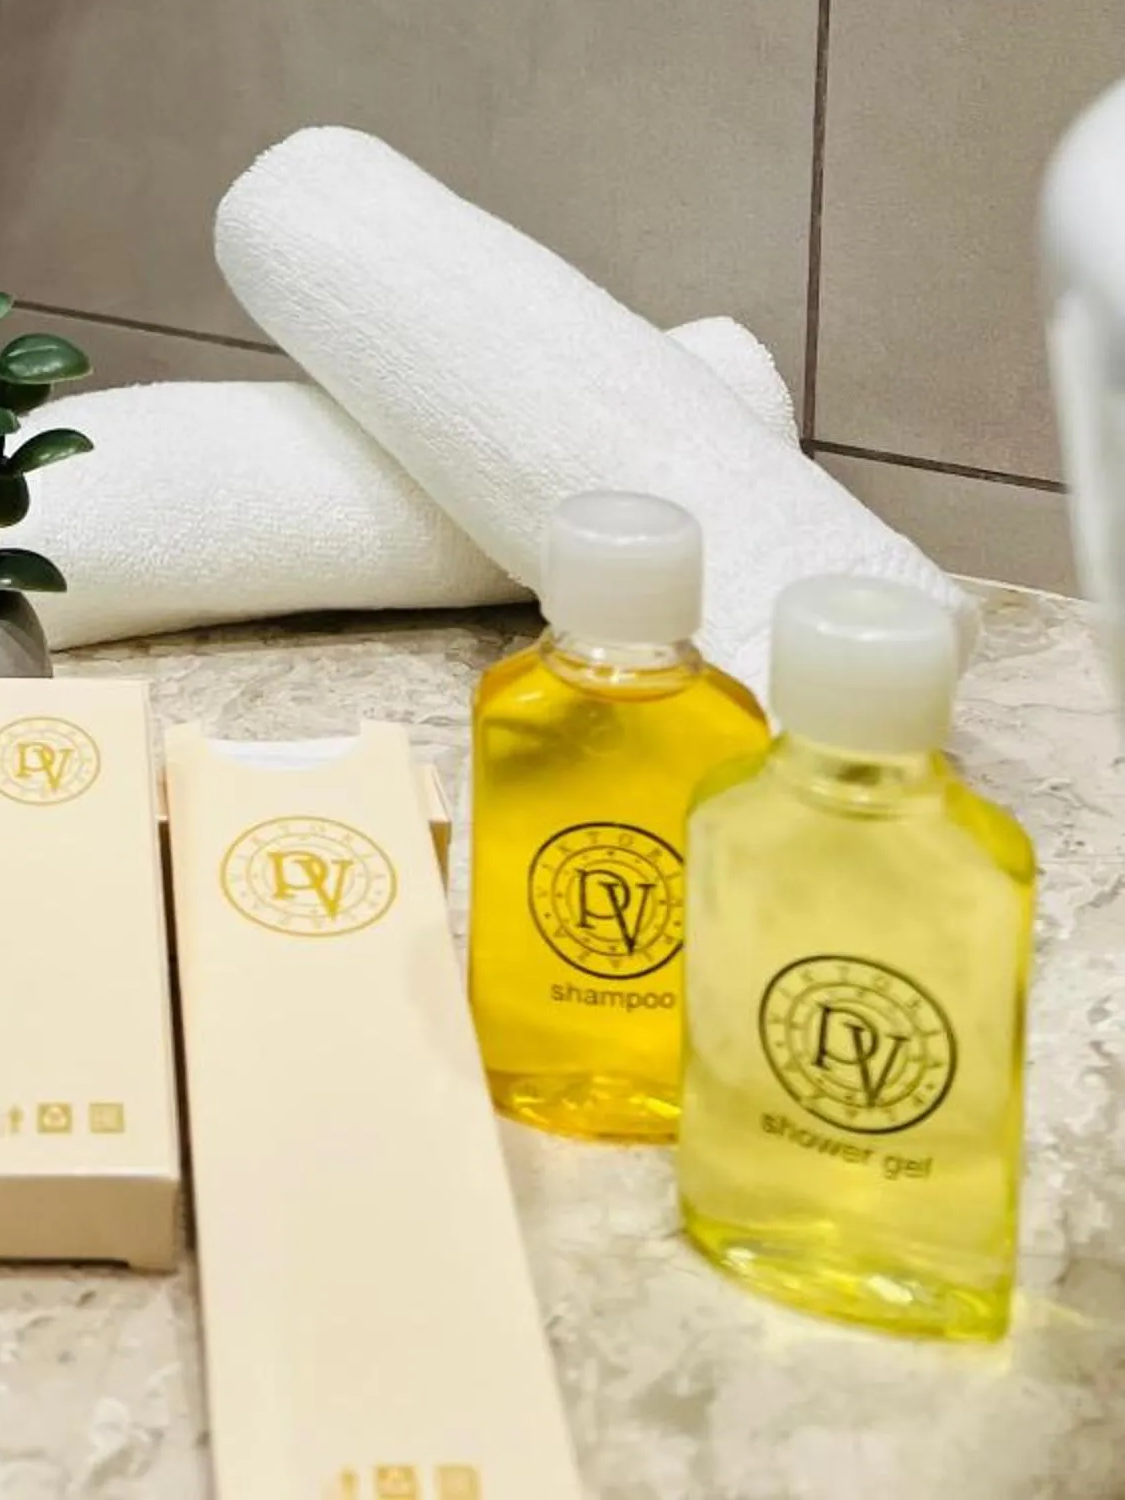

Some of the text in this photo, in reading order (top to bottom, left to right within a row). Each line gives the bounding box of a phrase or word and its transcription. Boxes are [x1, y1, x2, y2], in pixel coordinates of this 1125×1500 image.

[550, 981, 676, 1013] shampoo
[760, 1111, 935, 1182] shower gel
